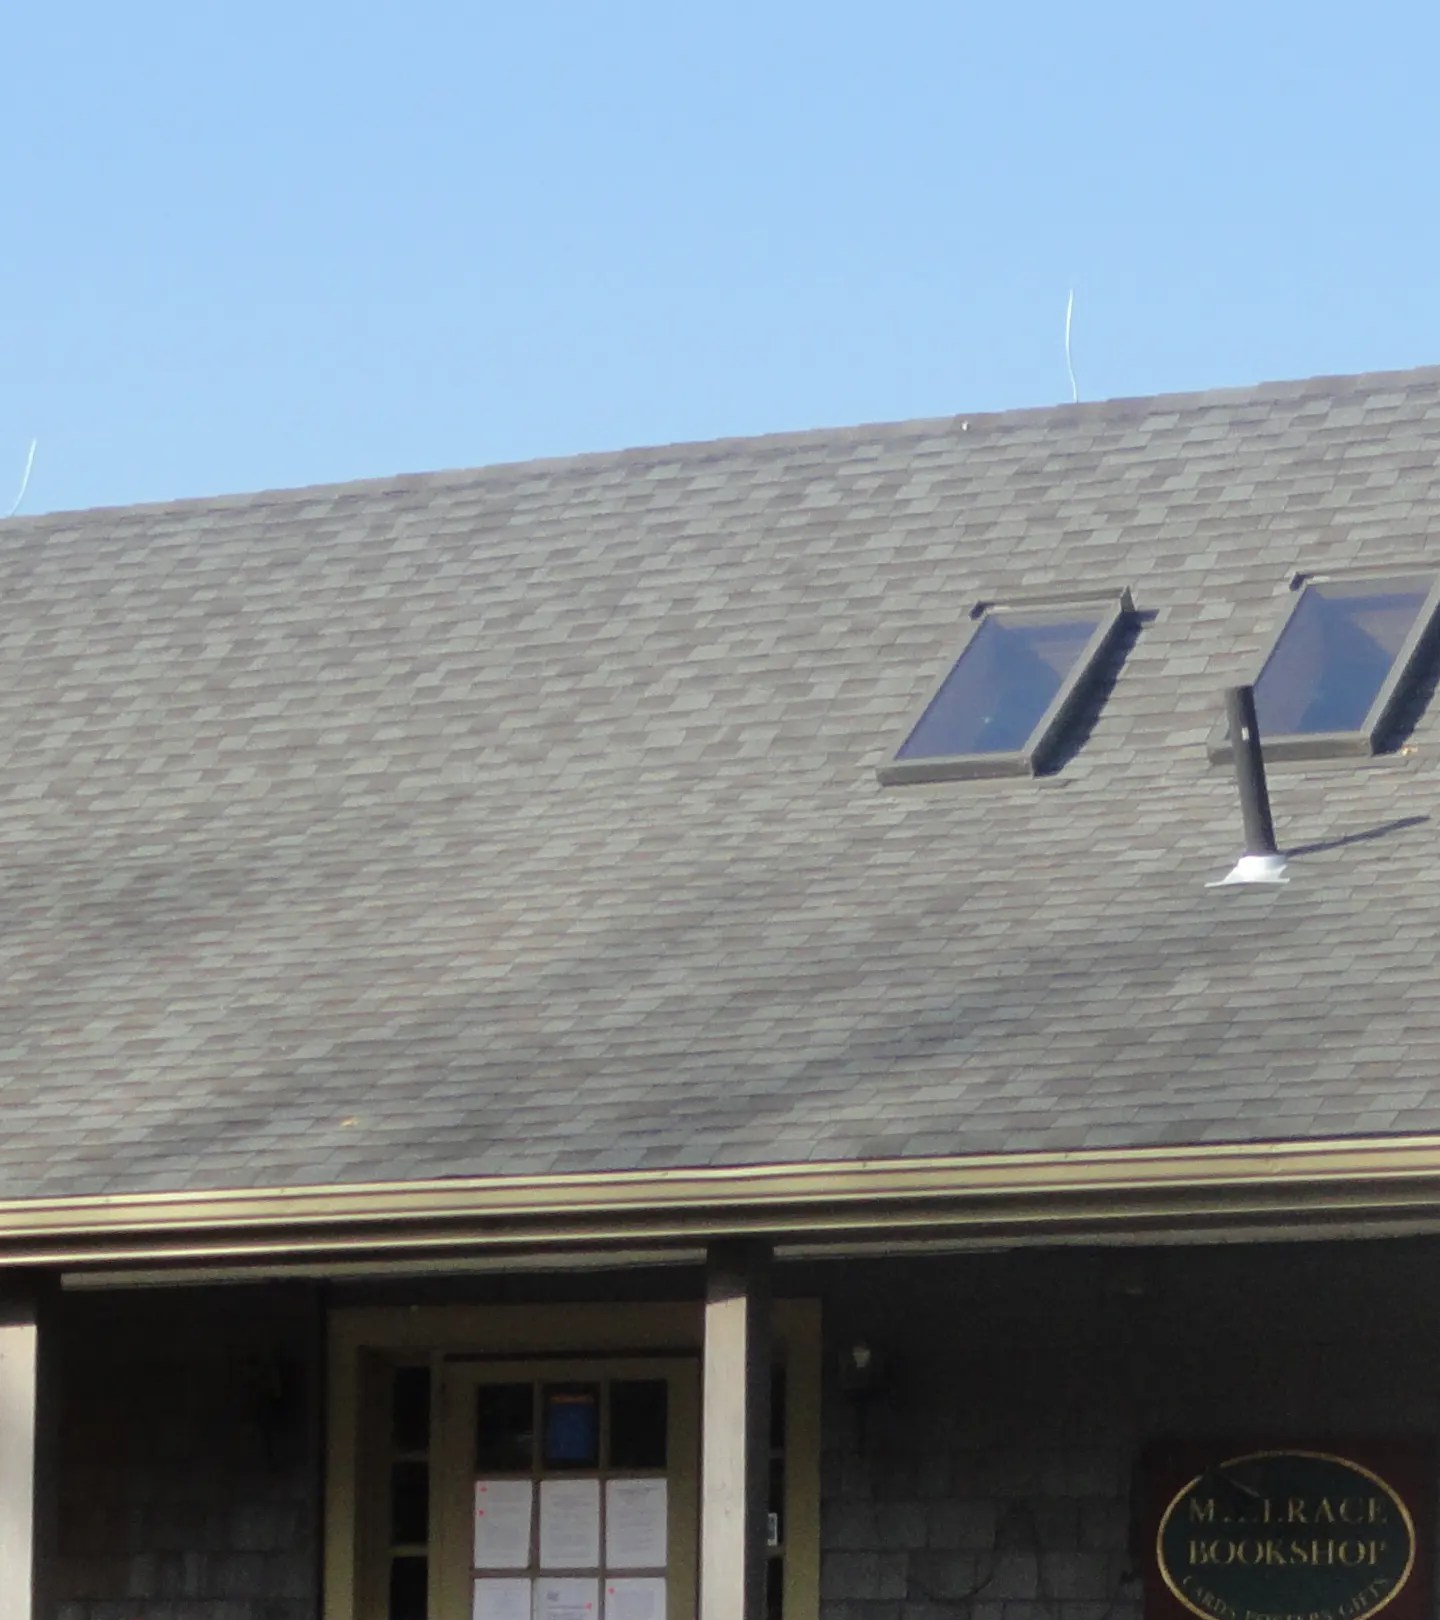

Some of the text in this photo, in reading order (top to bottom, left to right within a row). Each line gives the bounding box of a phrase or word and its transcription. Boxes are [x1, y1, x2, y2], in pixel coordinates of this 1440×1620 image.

[1189, 1496, 1388, 1524] MLRACE
[1188, 1539, 1387, 1566] BOOKSHOP
[1182, 1575, 1237, 1619] CARDS
